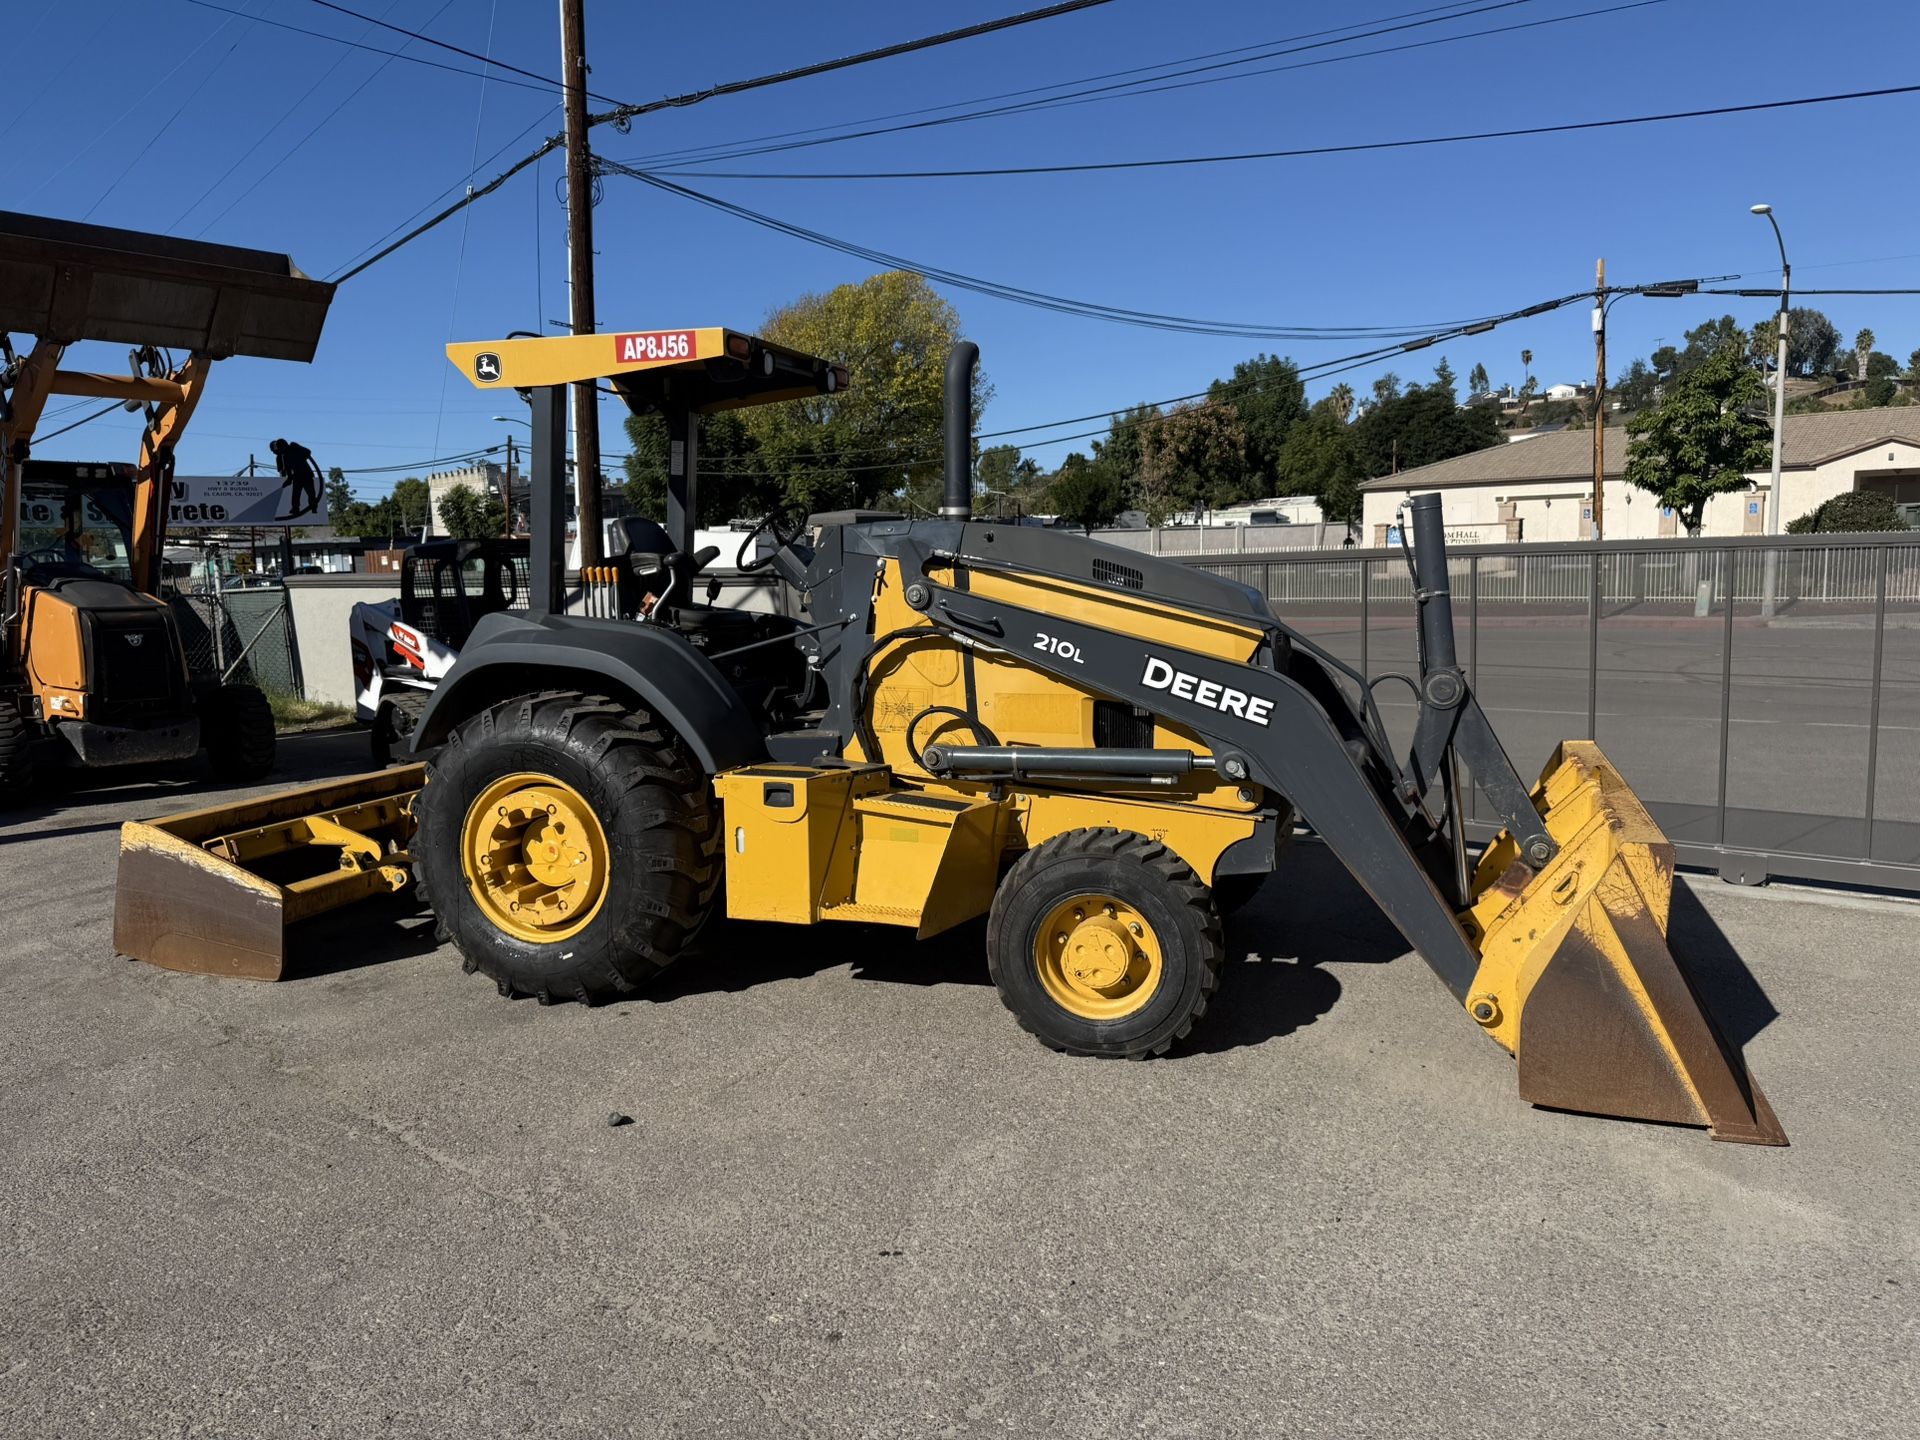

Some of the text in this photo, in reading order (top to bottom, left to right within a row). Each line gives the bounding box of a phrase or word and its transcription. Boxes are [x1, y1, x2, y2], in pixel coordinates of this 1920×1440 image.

[623, 334, 689, 360] AP8J56
[1033, 632, 1085, 664] 210L
[1141, 657, 1275, 725] DEERE
